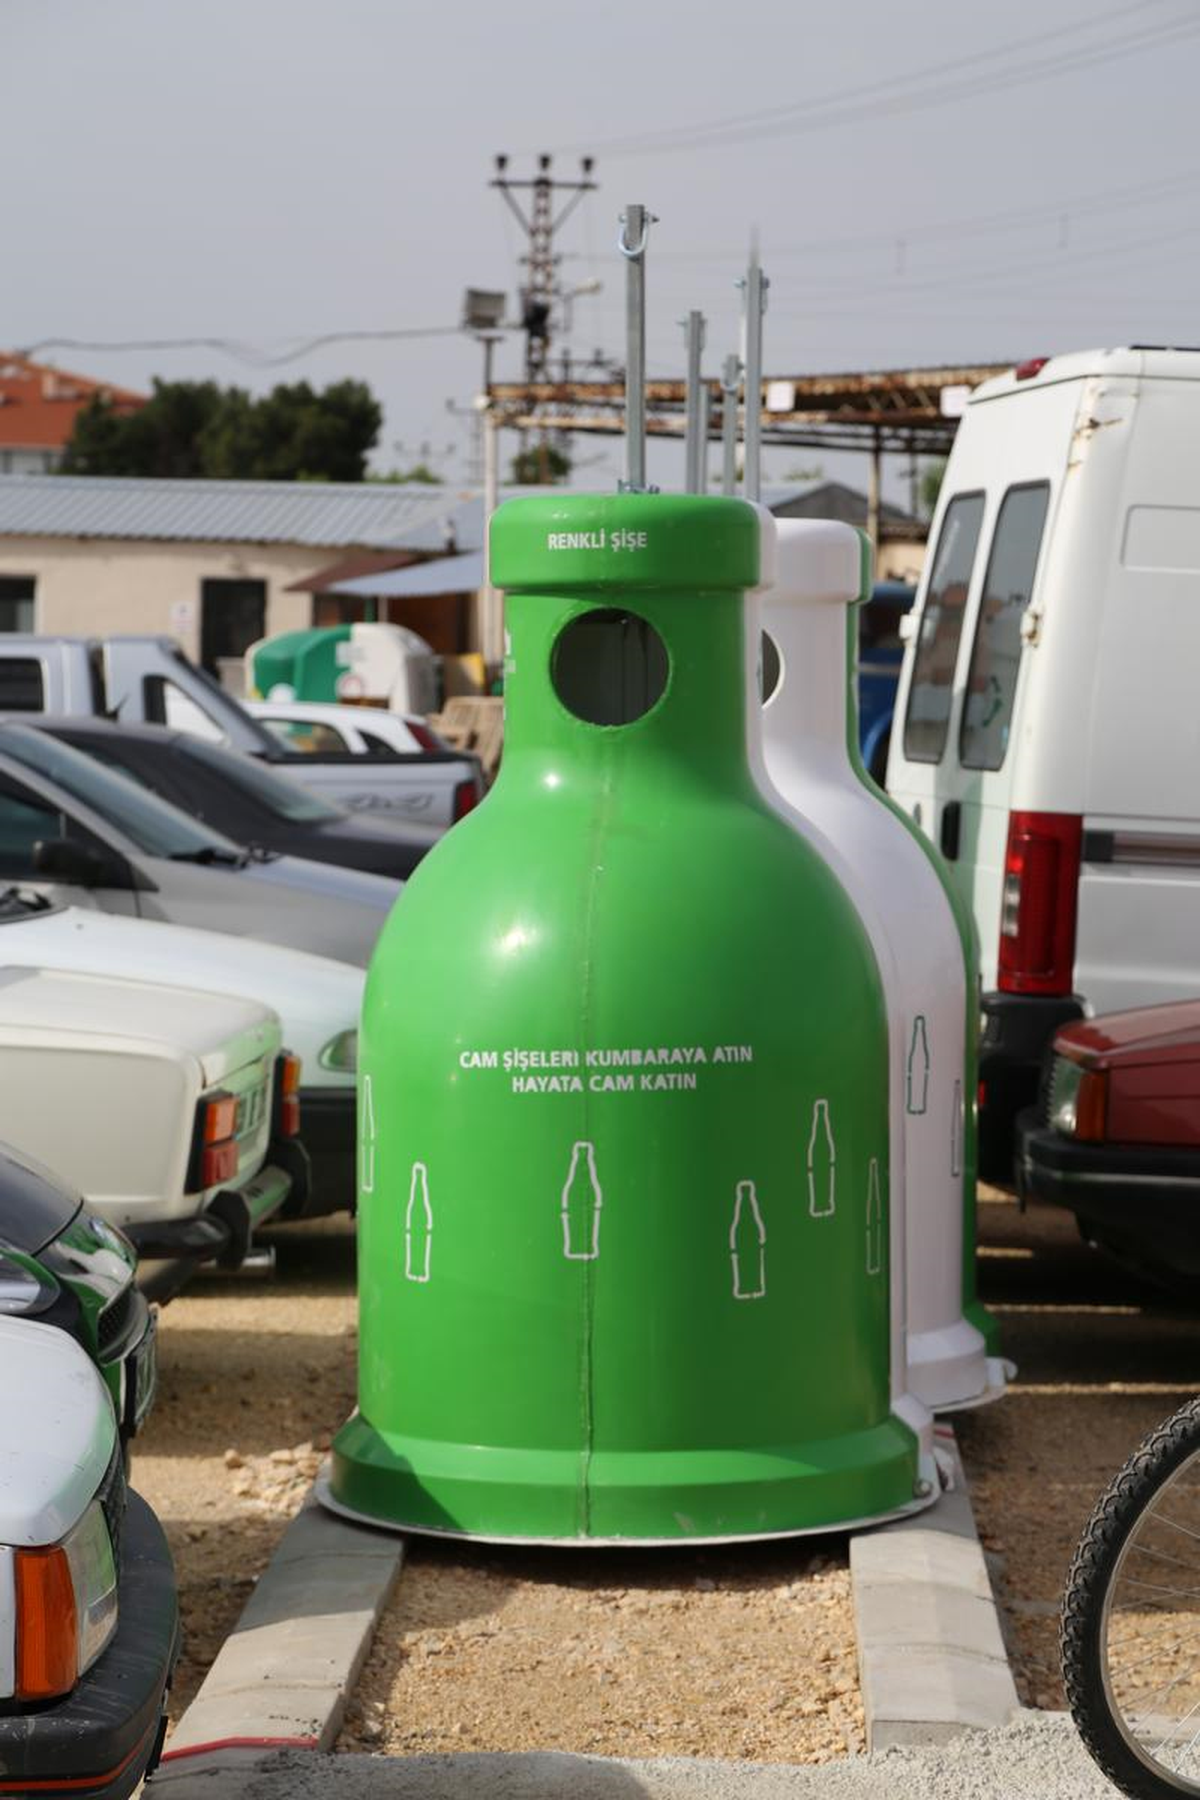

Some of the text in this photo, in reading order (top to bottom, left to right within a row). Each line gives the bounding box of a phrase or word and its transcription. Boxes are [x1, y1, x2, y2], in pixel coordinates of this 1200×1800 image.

[548, 528, 647, 552] RENKLİ ŞİŞE
[460, 1051, 498, 1068] CAM
[585, 1048, 706, 1066] KUMBARAYA
[713, 1045, 752, 1063] ATIN
[512, 1073, 696, 1092] HAYATA CAM KATIN
